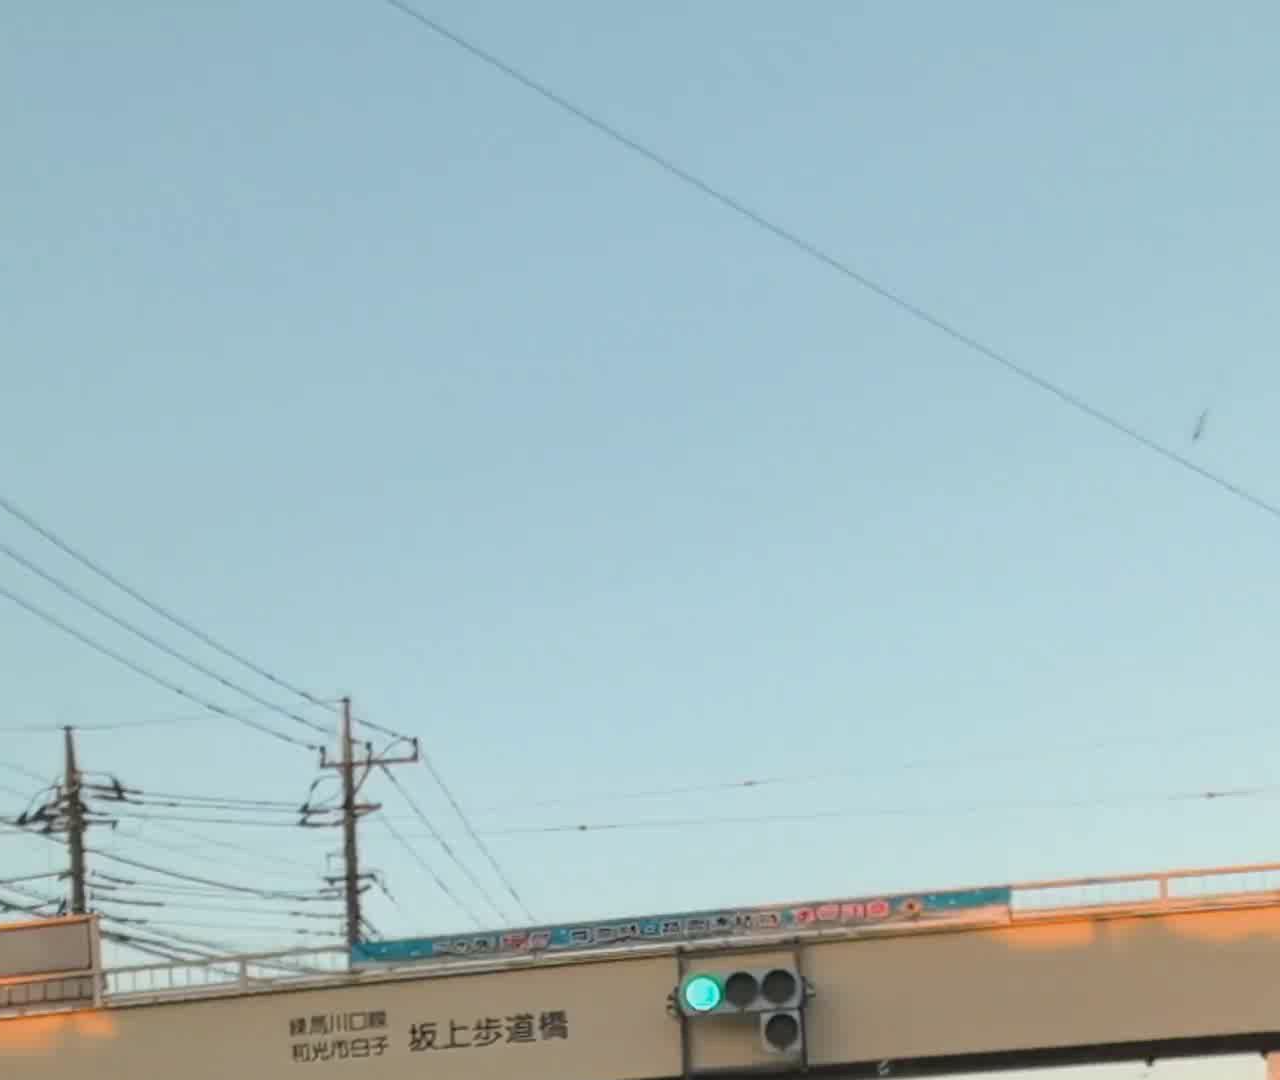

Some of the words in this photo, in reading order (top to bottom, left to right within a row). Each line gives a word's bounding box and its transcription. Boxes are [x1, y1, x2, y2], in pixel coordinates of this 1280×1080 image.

[408, 1010, 569, 1052] 坂上歩道橋
